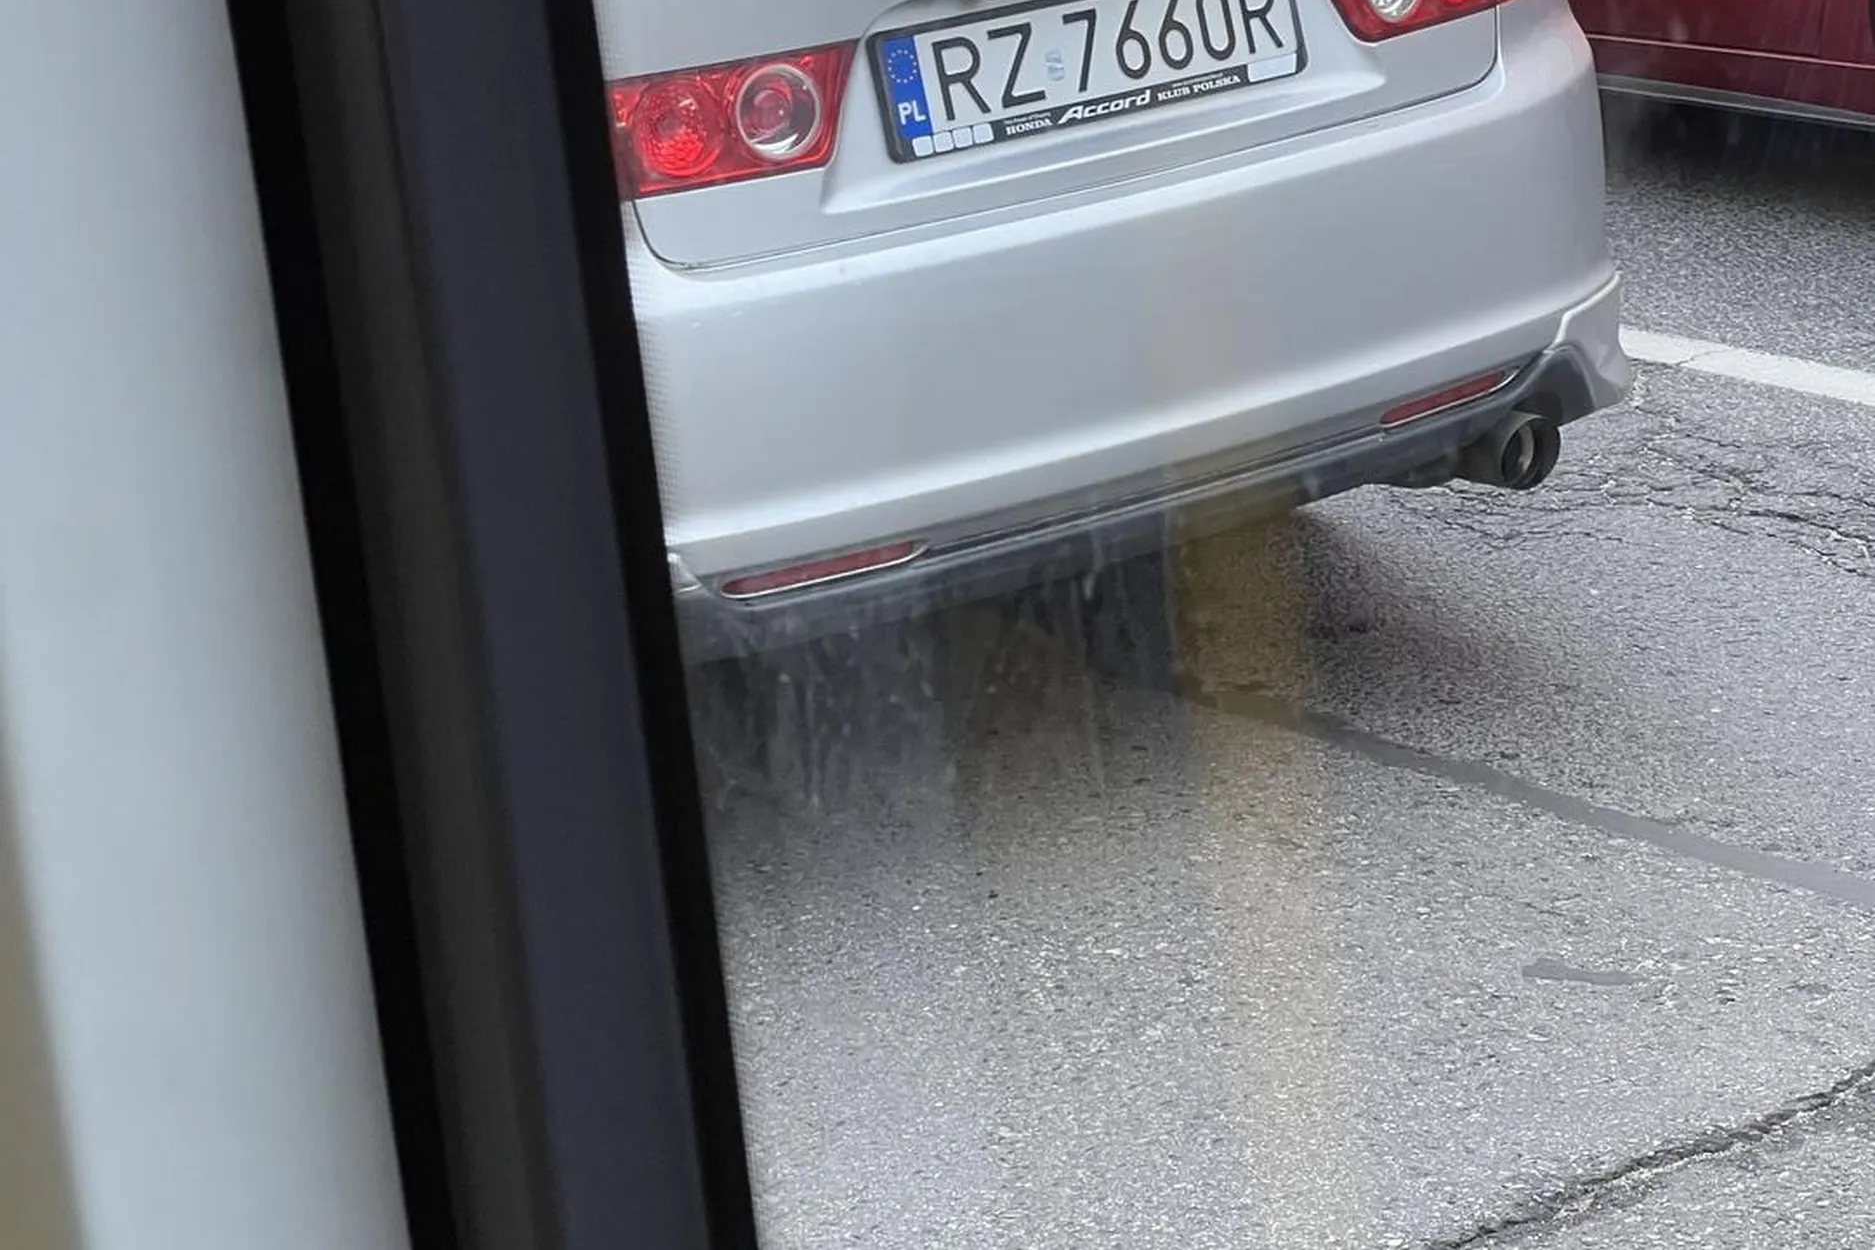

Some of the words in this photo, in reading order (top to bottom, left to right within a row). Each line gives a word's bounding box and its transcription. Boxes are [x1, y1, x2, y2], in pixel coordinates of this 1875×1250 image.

[931, 22, 1047, 121] RZ
[898, 100, 926, 125] PL
[1005, 118, 1053, 135] HONDA
[1057, 89, 1152, 125] Accord
[1157, 86, 1191, 101] KLUB
[1193, 74, 1241, 93] POLSKA
